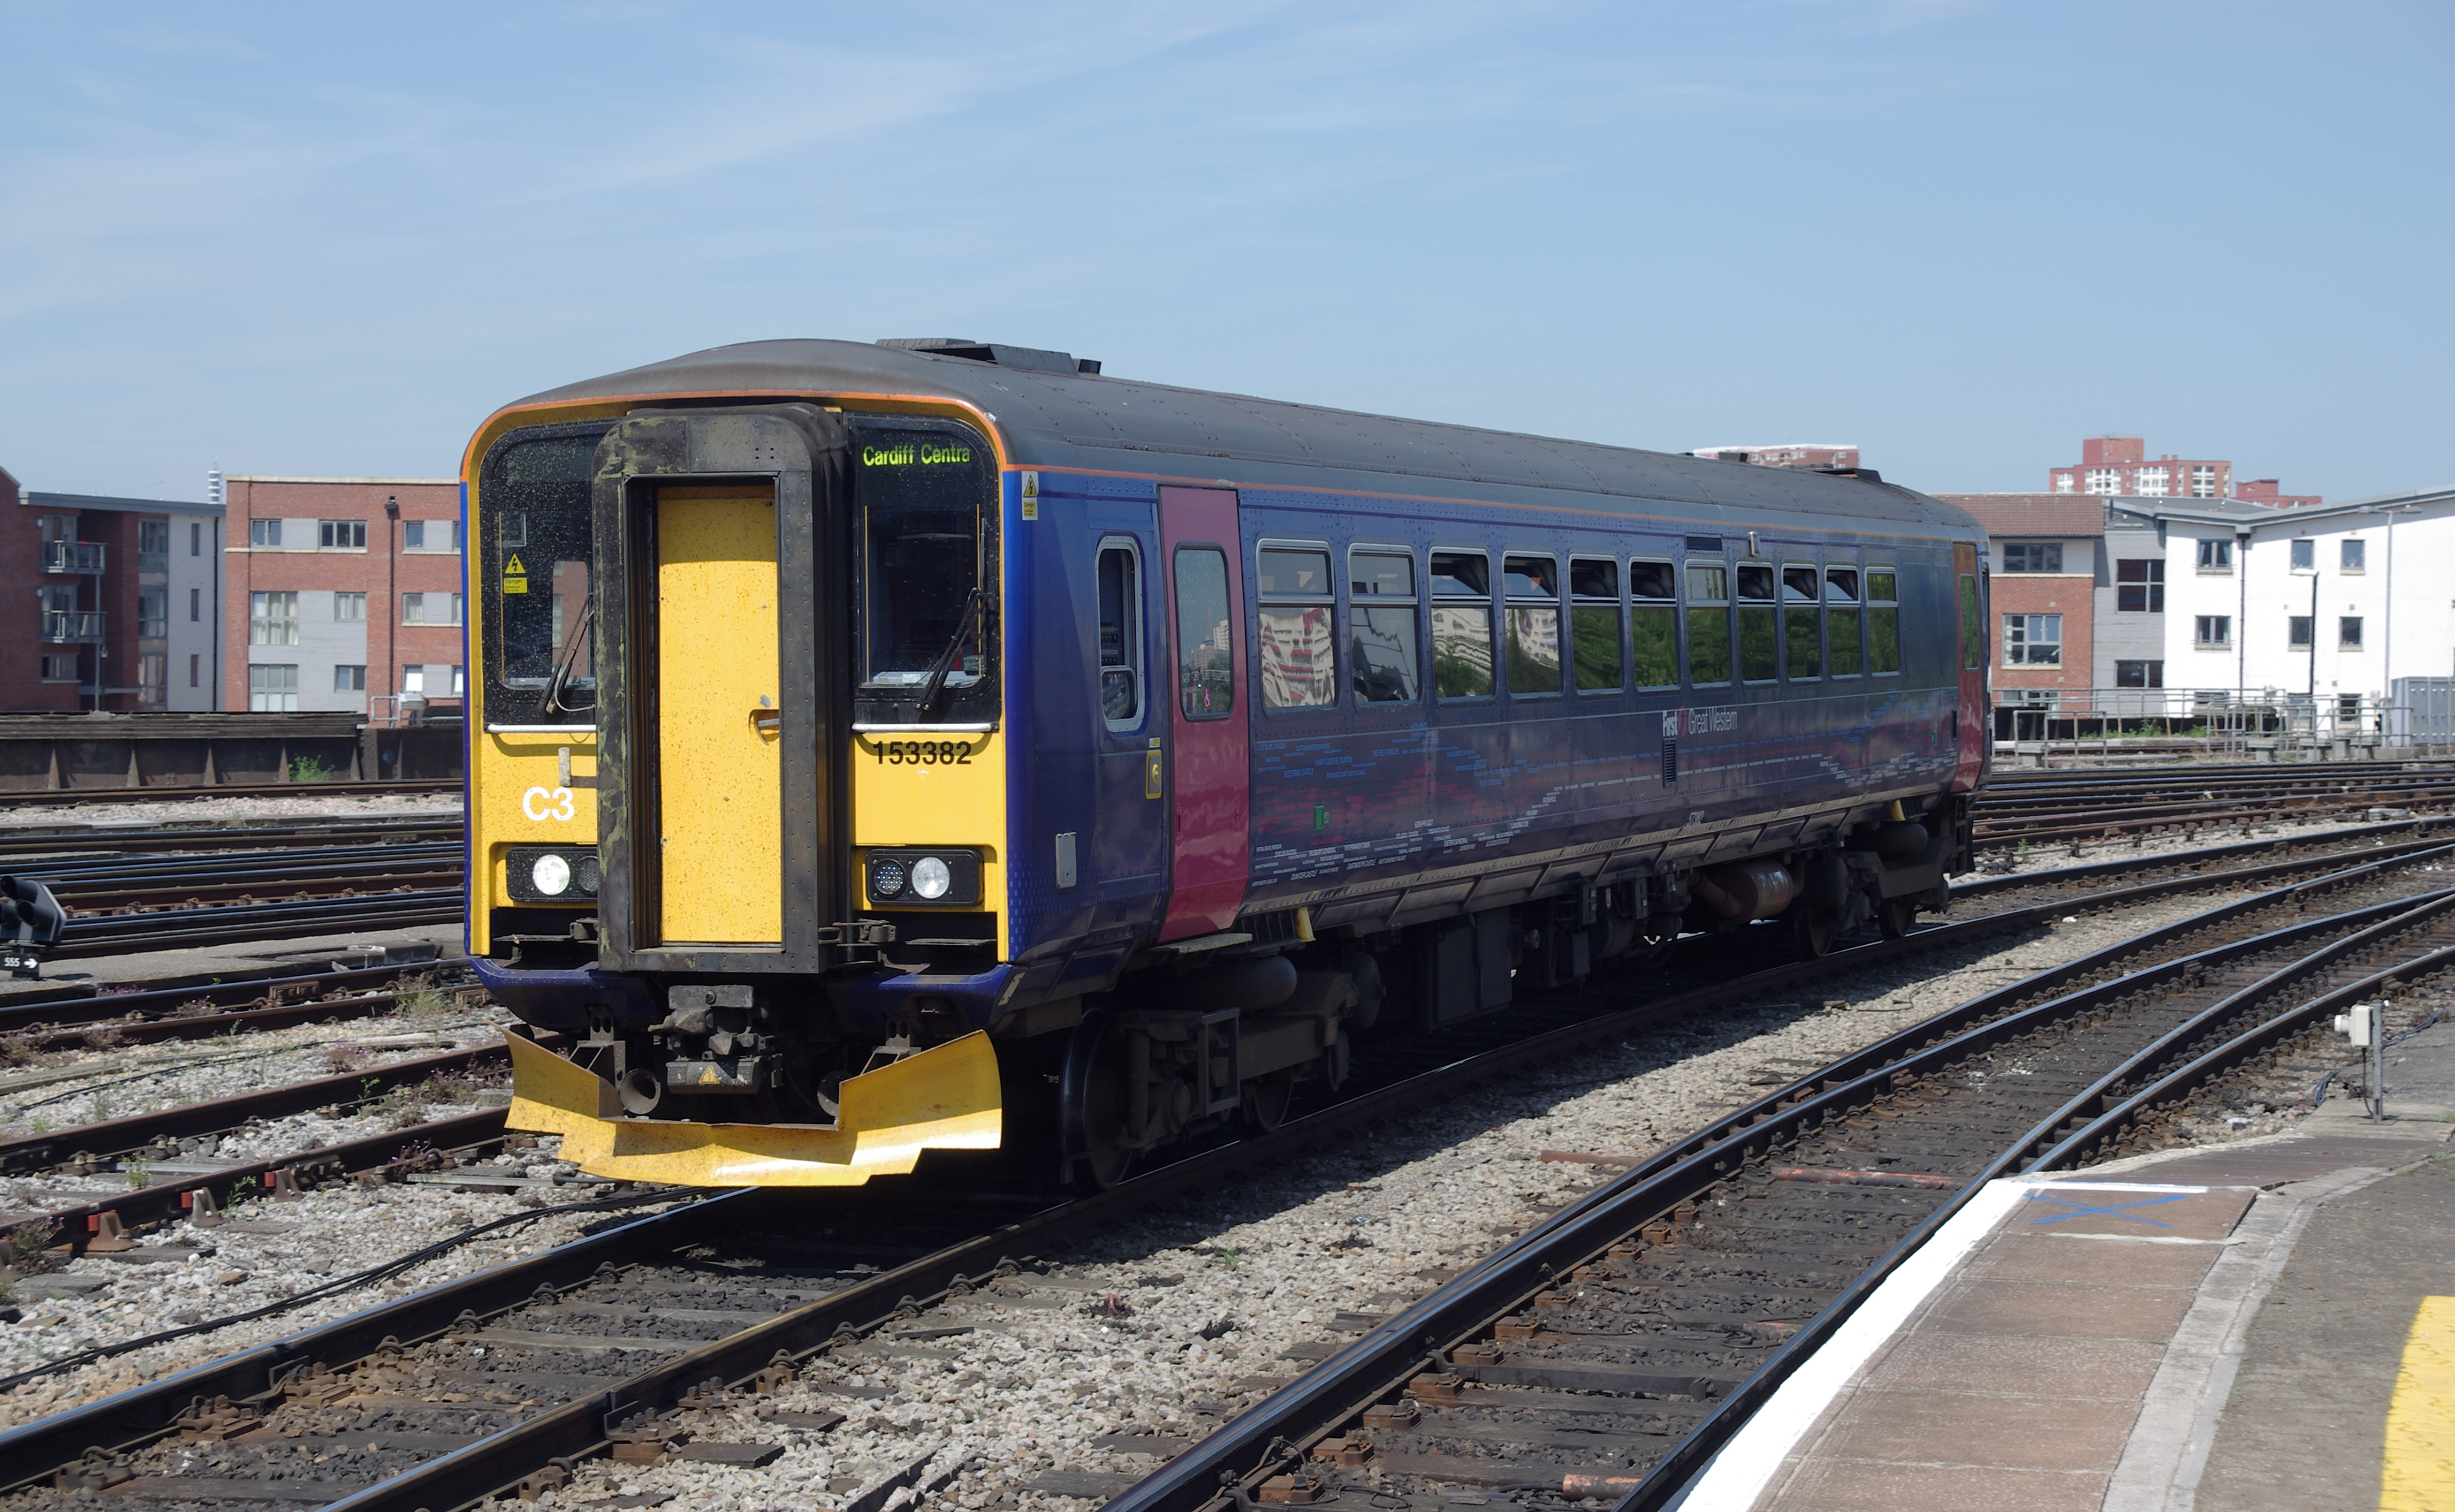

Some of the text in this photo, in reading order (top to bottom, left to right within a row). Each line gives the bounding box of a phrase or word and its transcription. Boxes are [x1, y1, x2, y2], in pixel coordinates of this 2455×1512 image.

[863, 445, 914, 466] Cardiff
[1662, 705, 1738, 737] First Great Western
[873, 741, 972, 765] 153382
[523, 786, 575, 821] C3
[4, 957, 21, 967] 555
